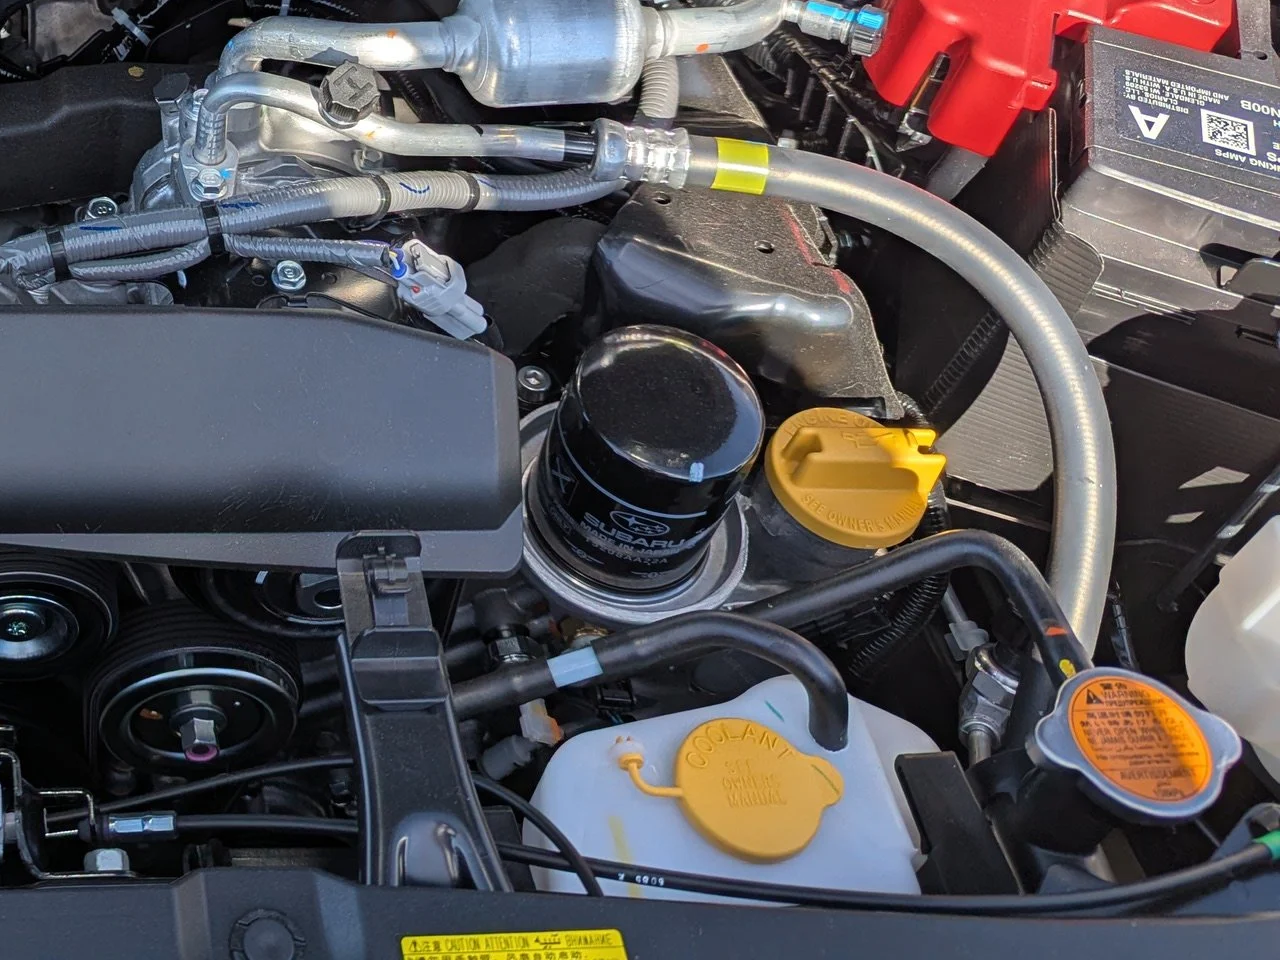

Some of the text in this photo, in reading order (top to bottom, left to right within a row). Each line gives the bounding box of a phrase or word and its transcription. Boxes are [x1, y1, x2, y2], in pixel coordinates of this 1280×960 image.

[1125, 69, 1230, 101] AND IMPORTED MATERIALS
[1140, 79, 1160, 89] WITH
[1150, 87, 1160, 95] WI
[1137, 95, 1189, 114] DISTRIBUTED
[1198, 95, 1221, 104] MADE
[1128, 104, 1170, 140] A
[1214, 148, 1246, 163] AMPS
[802, 493, 827, 515] SEE
[583, 512, 688, 549] SUBARU
[685, 722, 796, 770] COOLANT
[445, 938, 480, 952] CAUTION
[484, 936, 530, 951] ATTENTION
